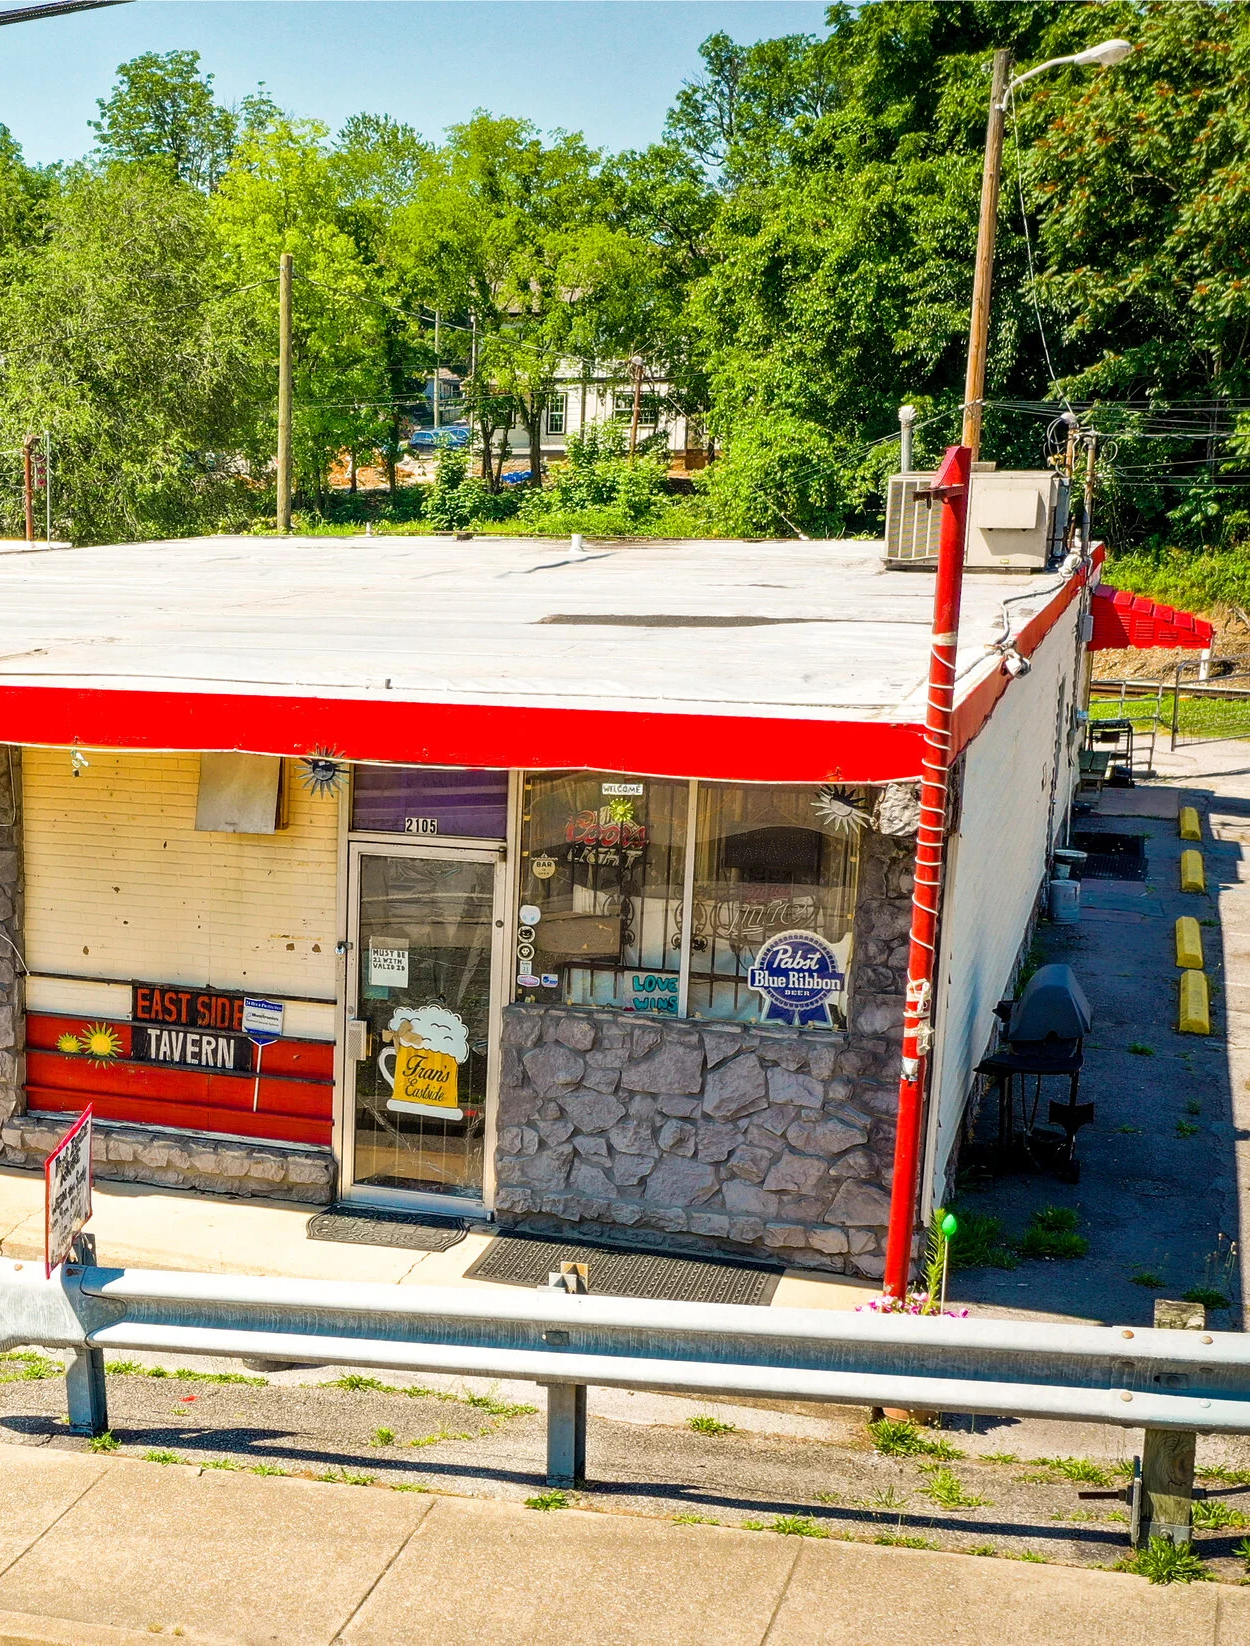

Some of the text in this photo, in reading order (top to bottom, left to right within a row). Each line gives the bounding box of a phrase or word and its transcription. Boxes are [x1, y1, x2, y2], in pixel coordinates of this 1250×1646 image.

[603, 785, 642, 794] WELCOME
[406, 818, 437, 833] 2105
[373, 949, 395, 957] MUST
[772, 944, 822, 970] Pabst
[373, 962, 396, 970] VALID
[632, 974, 678, 993] LOVE
[753, 969, 841, 990] Blue Ribbon
[784, 989, 811, 997] BEER
[136, 987, 244, 1031] EAST SIDE
[632, 995, 678, 1013] WINS
[147, 1028, 235, 1070] TAVERN
[402, 1054, 451, 1083] Fran's
[405, 1077, 445, 1102] Eastside
